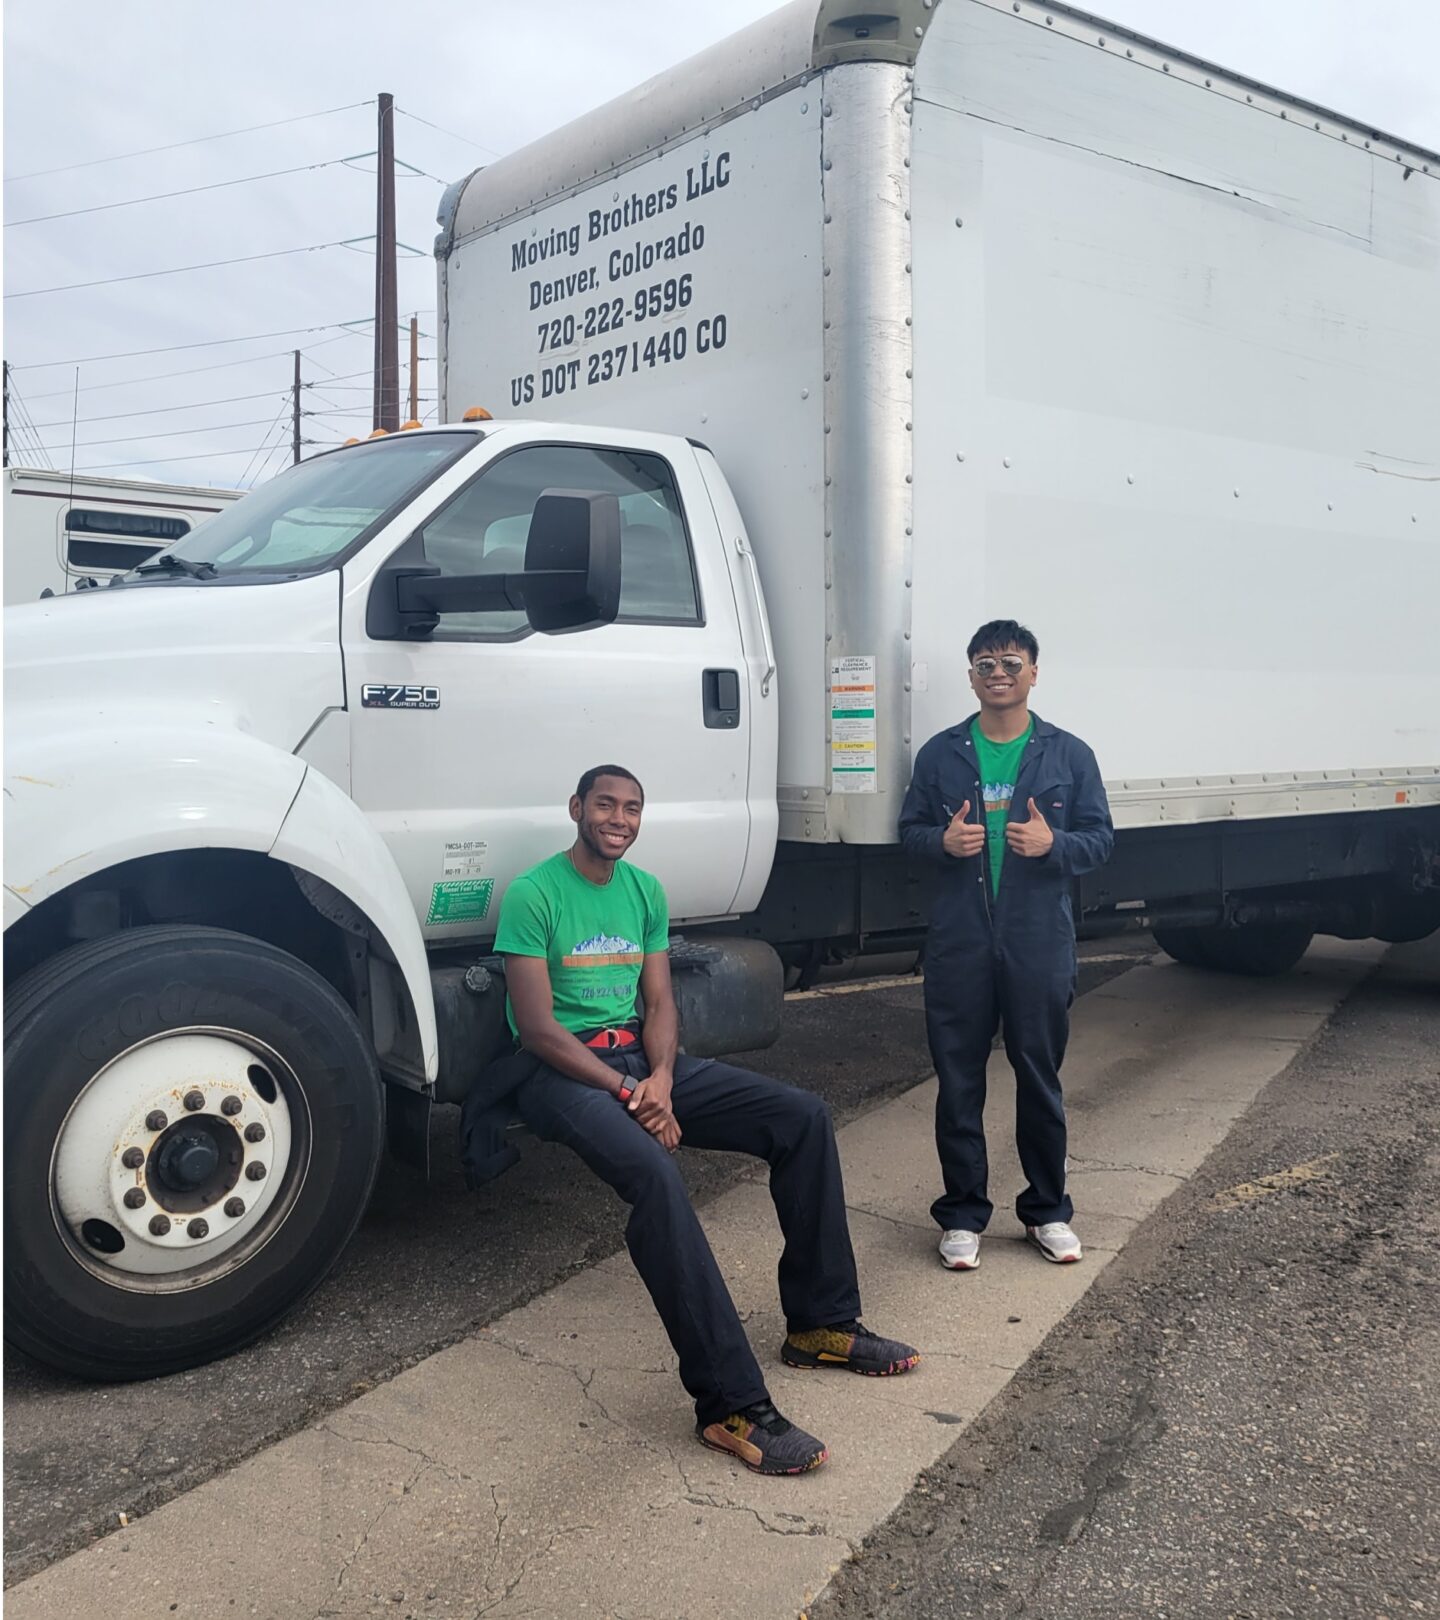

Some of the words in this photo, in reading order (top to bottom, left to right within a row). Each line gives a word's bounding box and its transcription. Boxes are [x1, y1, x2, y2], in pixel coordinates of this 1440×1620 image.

[511, 224, 580, 272] Moving
[588, 183, 678, 242] Brothers
[686, 152, 730, 201] LLC
[529, 266, 600, 311] Denver,
[608, 221, 705, 282] Colorado
[538, 273, 693, 354] 720-222-9596
[511, 374, 535, 407] US
[541, 359, 580, 399] DOT
[587, 326, 687, 386] 2371440
[696, 314, 727, 354] CO
